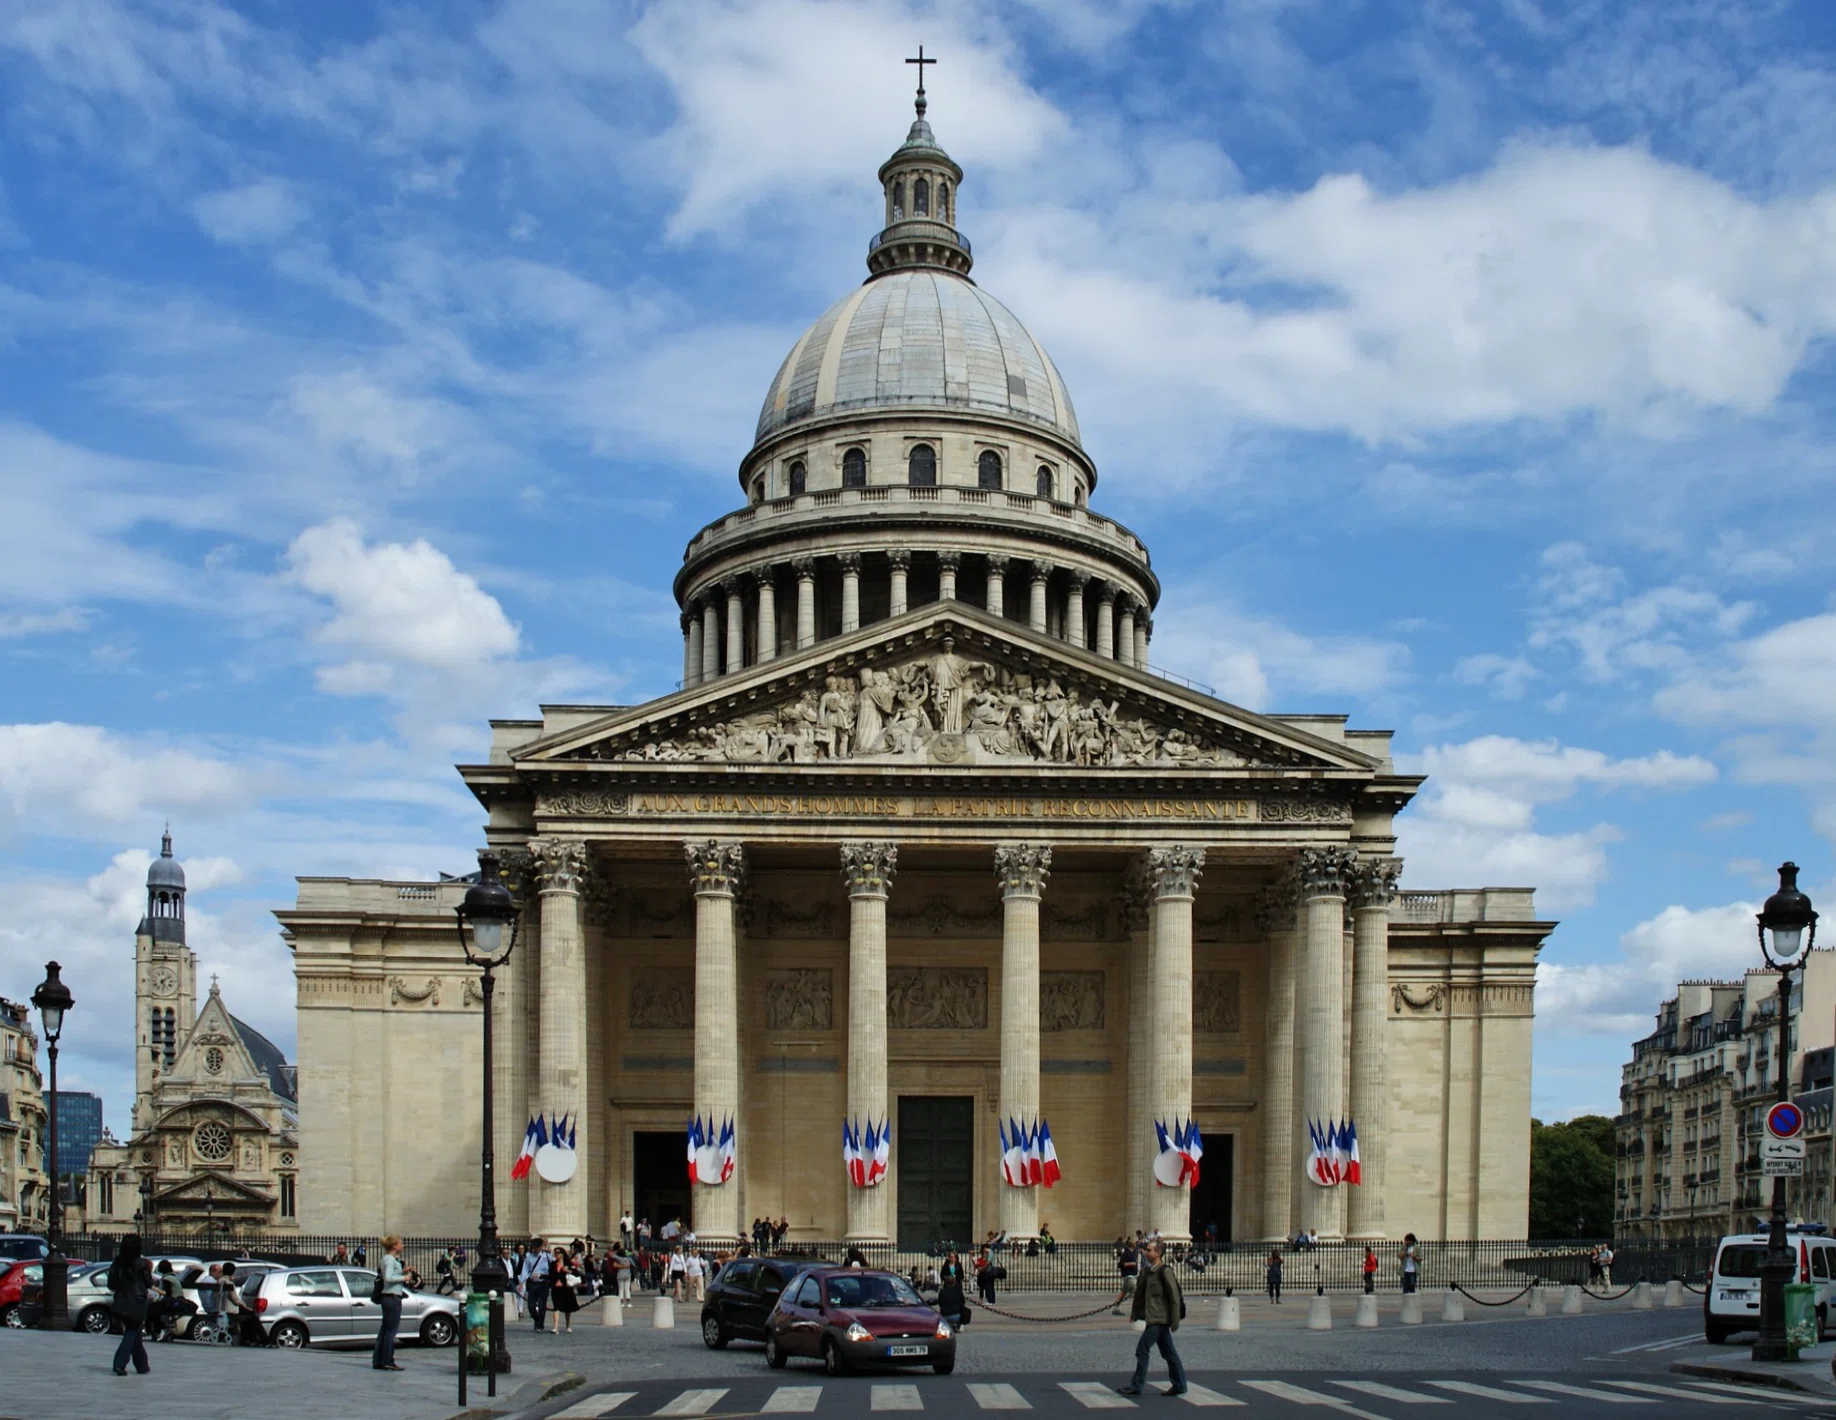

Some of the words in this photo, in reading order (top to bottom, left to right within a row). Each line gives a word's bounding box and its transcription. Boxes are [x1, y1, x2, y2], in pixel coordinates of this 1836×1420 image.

[637, 795, 688, 813] AUX
[693, 795, 793, 815] GRANDS
[797, 796, 899, 815] HOMMES
[913, 797, 944, 816] LA
[950, 797, 1034, 817] PATRIE
[1041, 797, 1250, 818] RECONNAISSANTE
